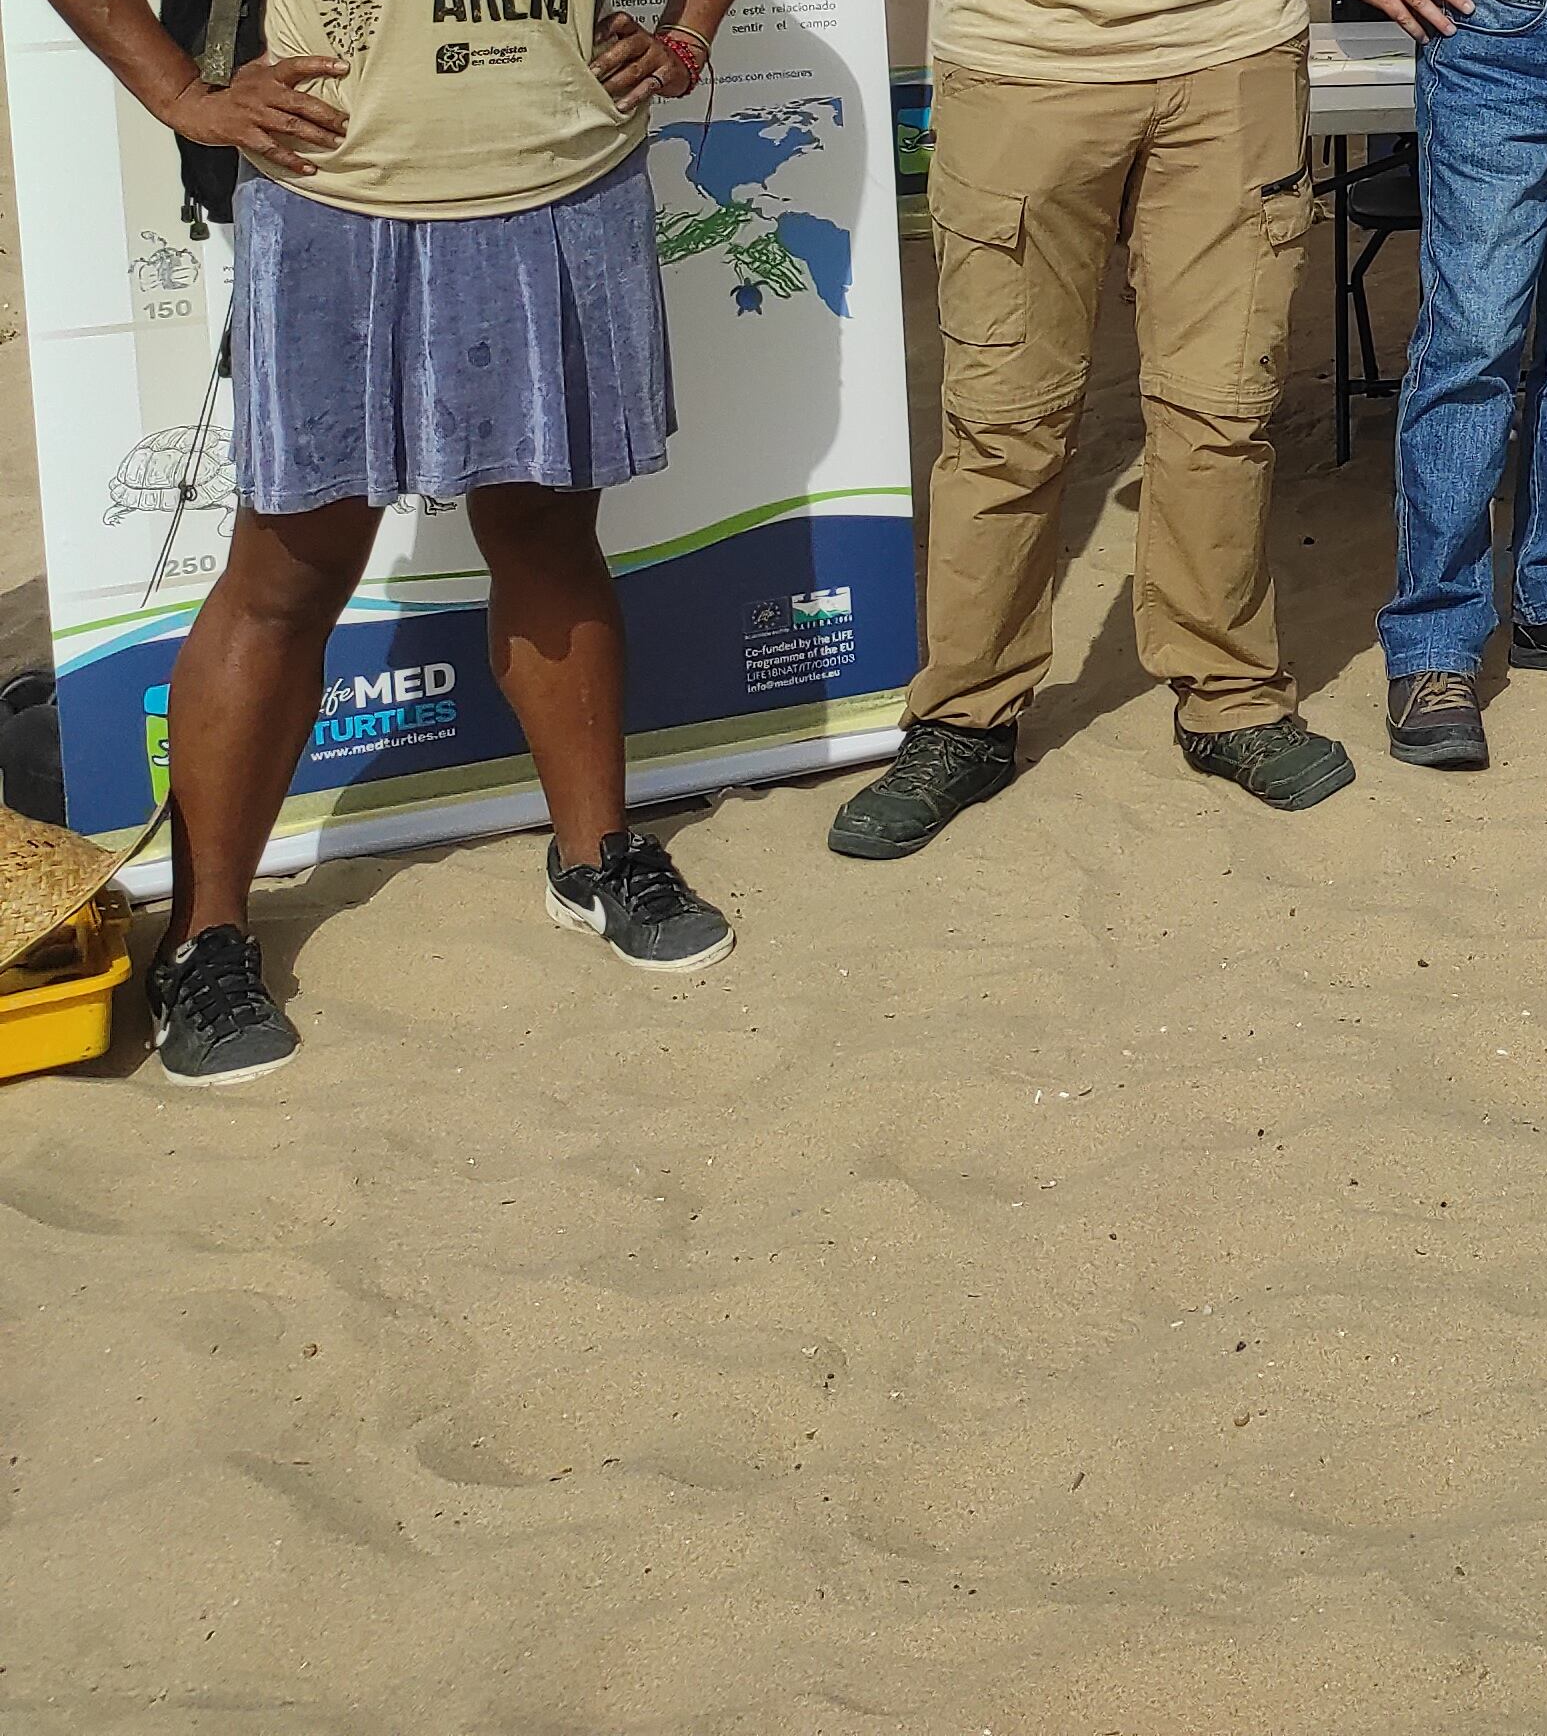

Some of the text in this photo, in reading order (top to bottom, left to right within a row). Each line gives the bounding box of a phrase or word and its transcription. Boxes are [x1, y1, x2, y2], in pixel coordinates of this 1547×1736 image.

[731, 21, 788, 34] sentir el
[142, 298, 192, 319] 150
[165, 554, 217, 578] 250
[745, 629, 855, 659] Co-funded by the LIFE
[746, 641, 855, 670] Programme the EU
[353, 662, 457, 709] MED
[313, 699, 457, 746] TURTLES
[310, 727, 457, 762] www.medturtles.eu
